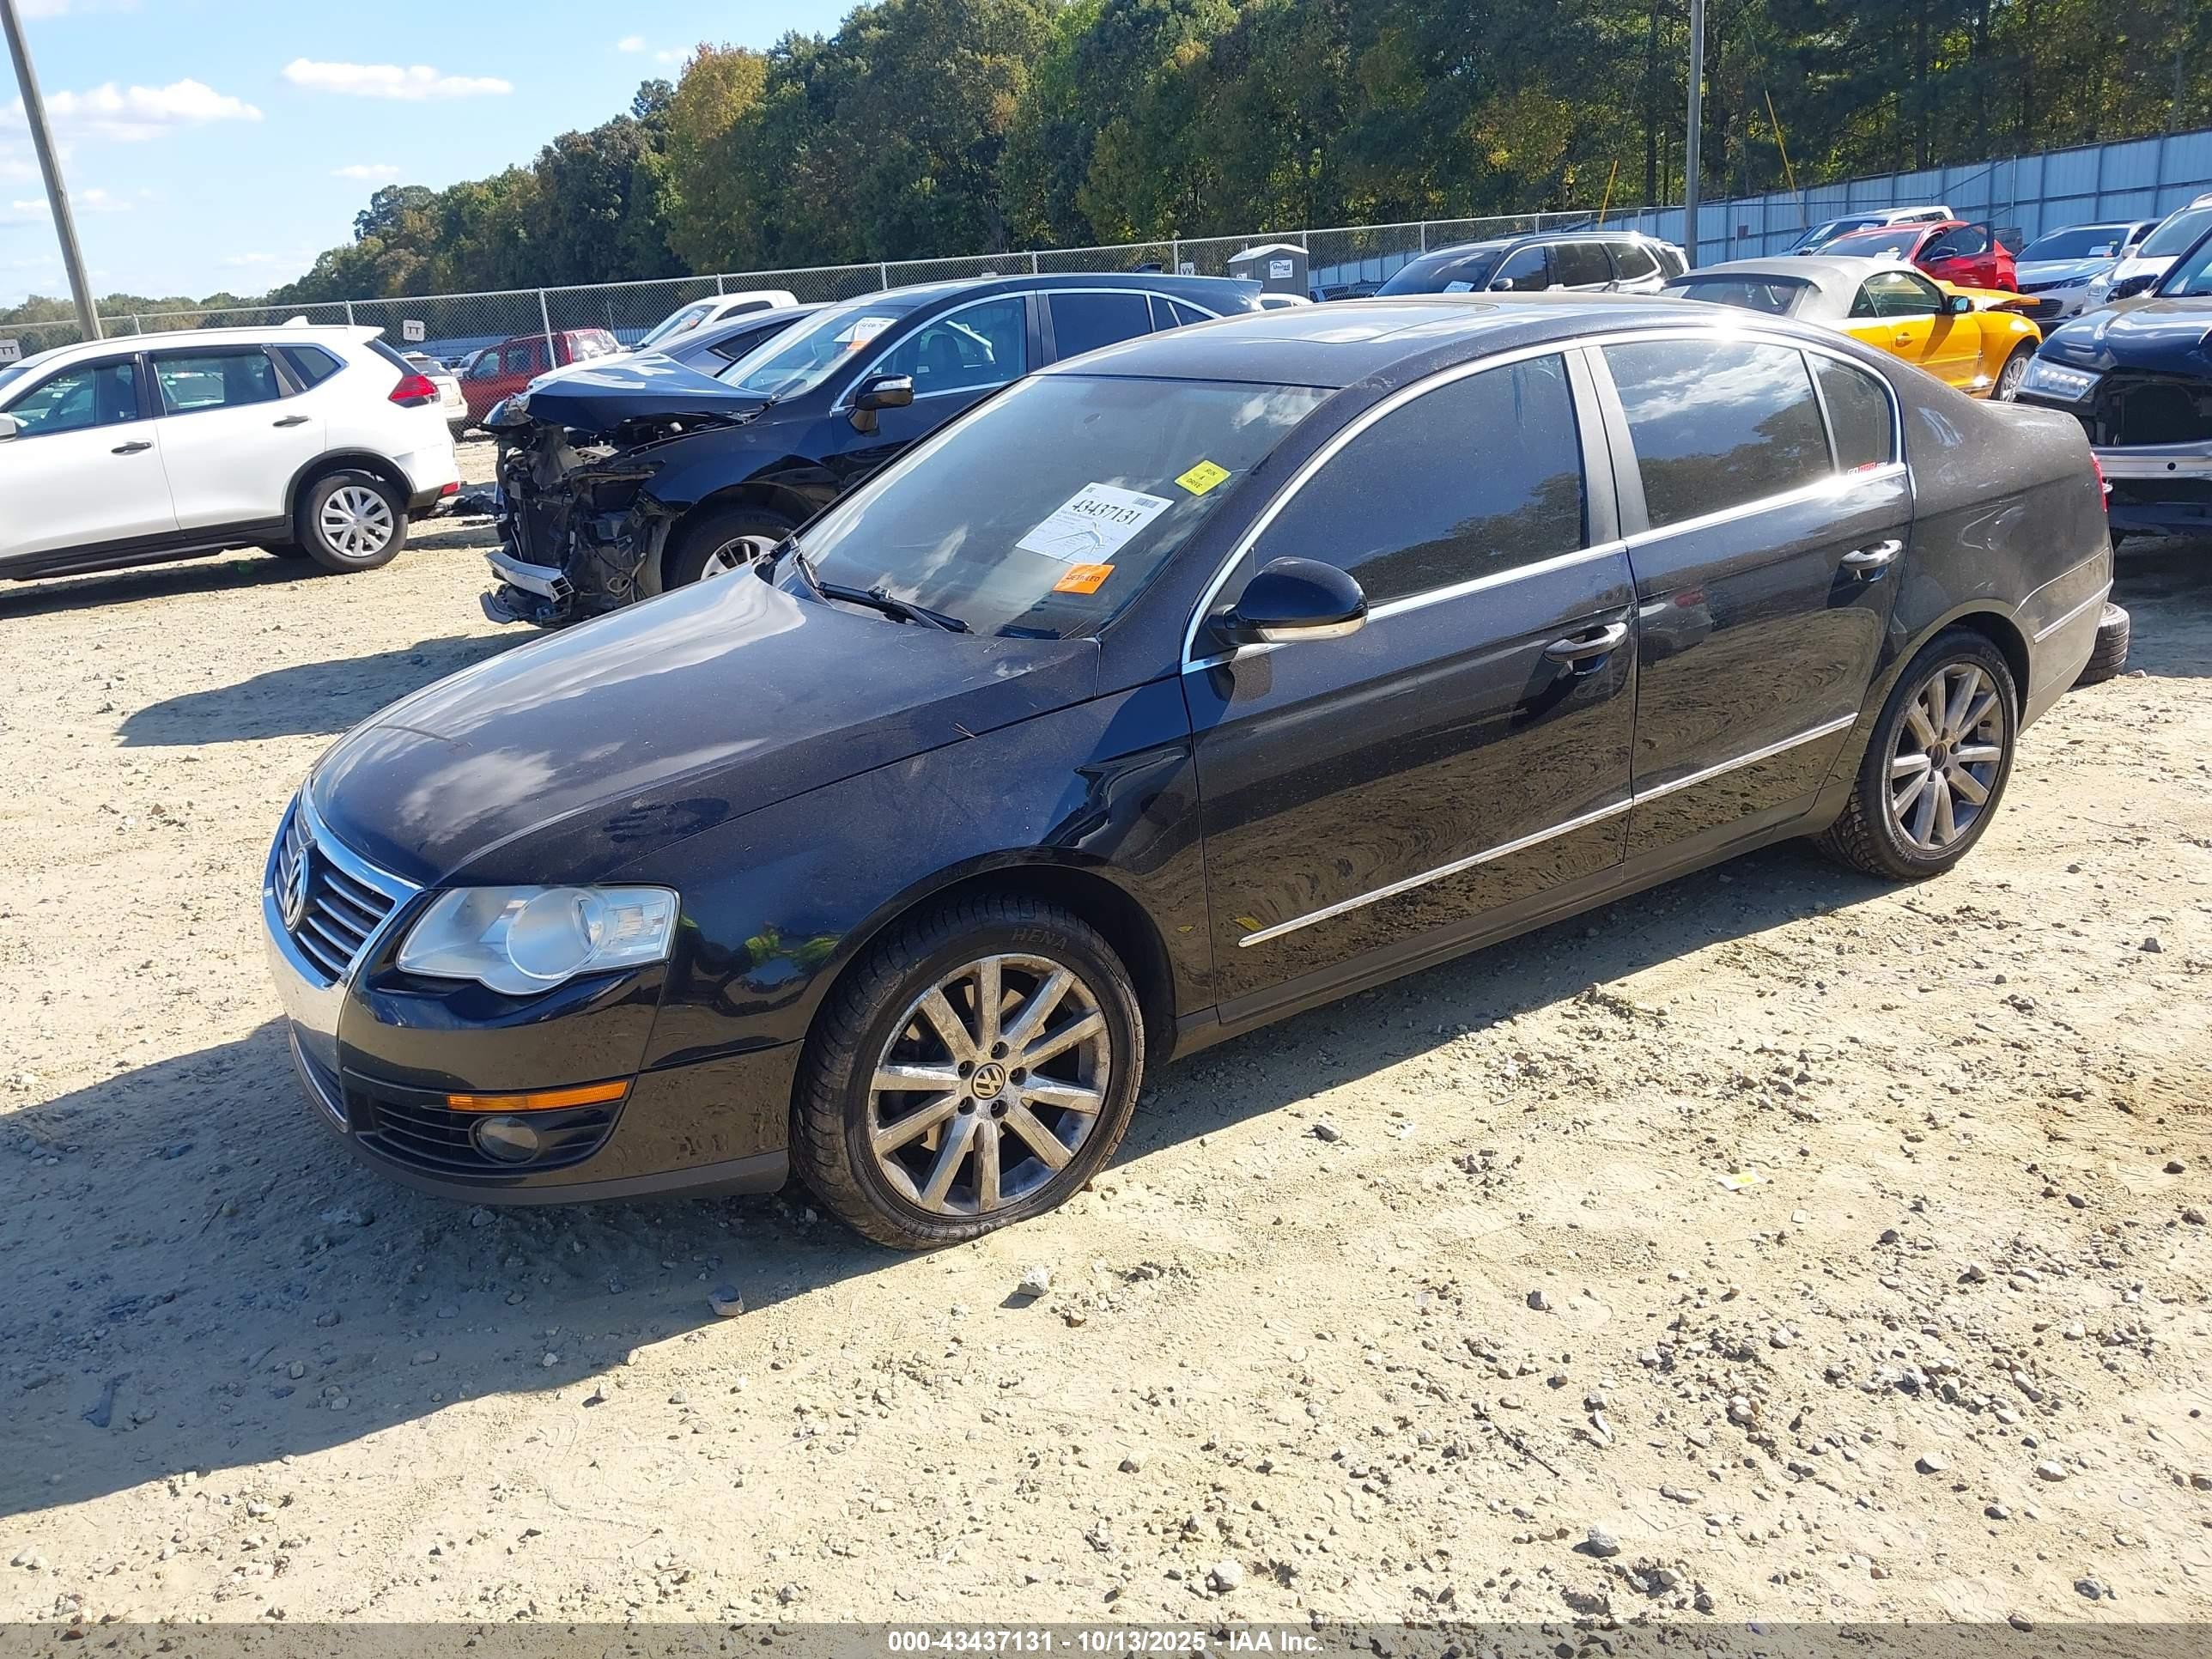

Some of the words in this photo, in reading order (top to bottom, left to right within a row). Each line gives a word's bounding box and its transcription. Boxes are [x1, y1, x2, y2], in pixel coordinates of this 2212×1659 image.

[407, 326, 421, 335] TT
[1186, 477, 1202, 488] DRIVE
[1072, 499, 1142, 526] 43437131
[1011, 928, 1068, 950] HENA
